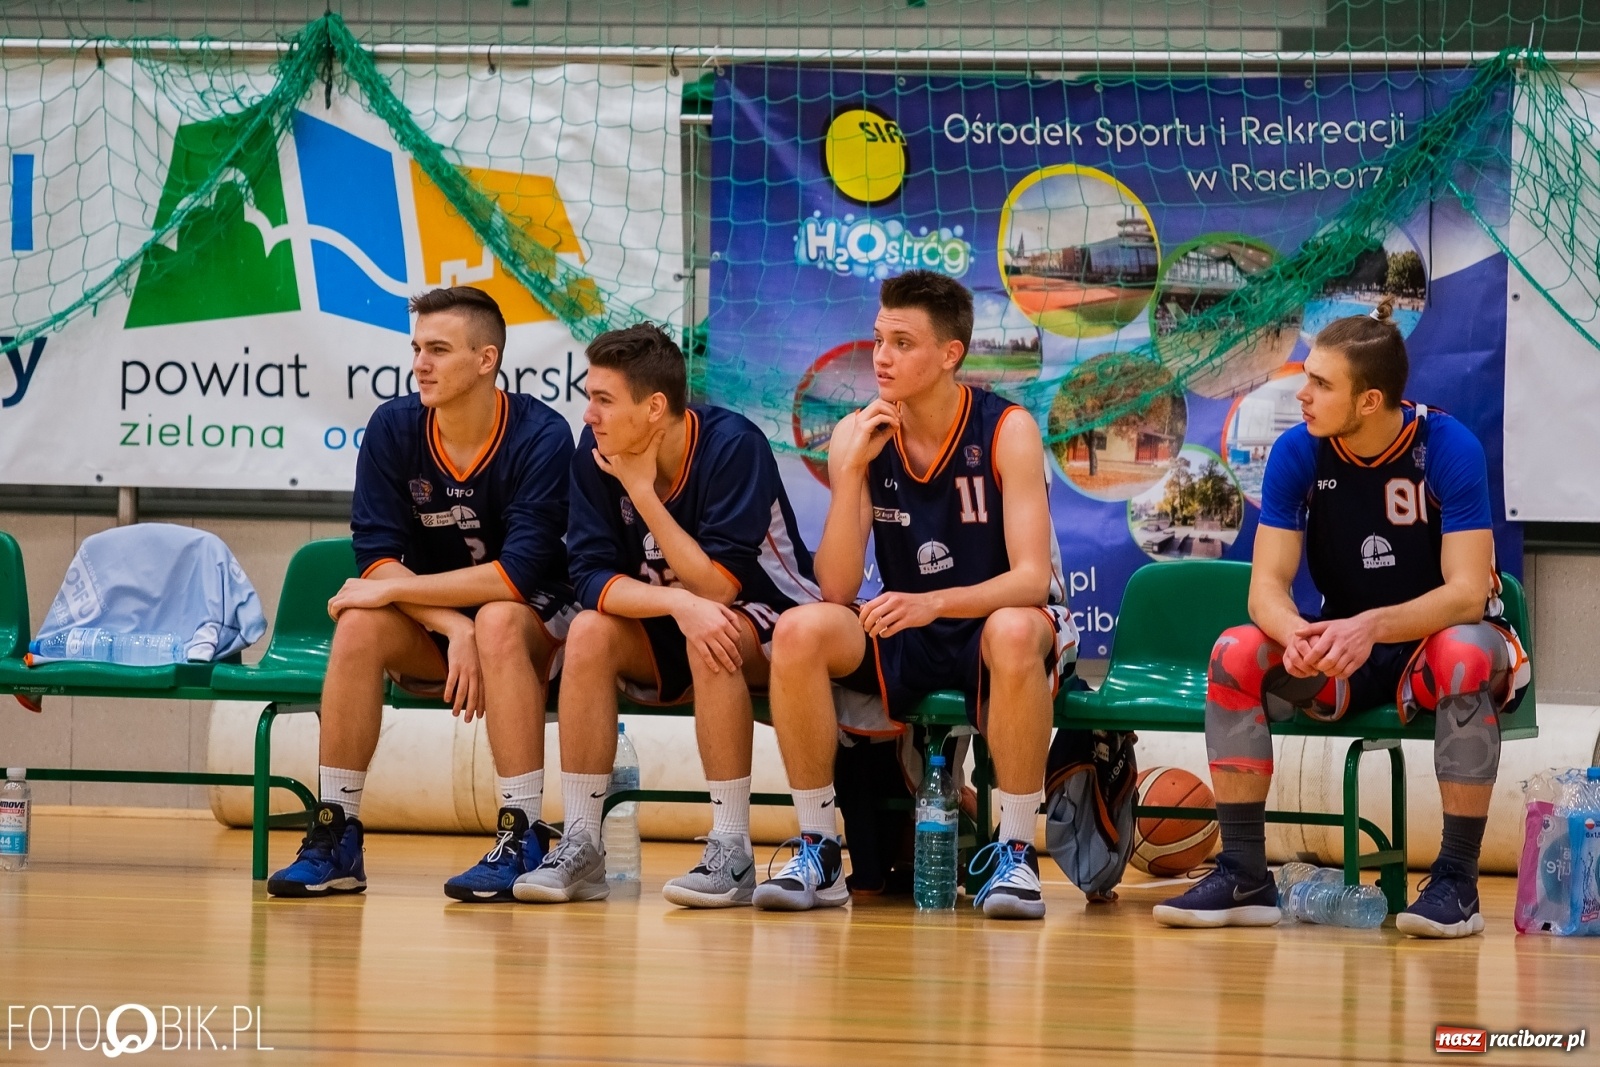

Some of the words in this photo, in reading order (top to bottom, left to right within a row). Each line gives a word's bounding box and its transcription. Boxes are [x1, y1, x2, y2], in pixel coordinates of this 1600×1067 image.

[943, 113, 1083, 146] Ośrodek
[1095, 116, 1205, 152] Sportu
[1219, 117, 1226, 146] i
[1241, 113, 1406, 150] Rekreacji
[1188, 167, 1217, 192] w
[121, 346, 310, 410] powiat
[119, 413, 284, 449] zielona
[955, 476, 987, 523] 11
[1317, 479, 1337, 490] FFO
[1385, 477, 1428, 525] 0
